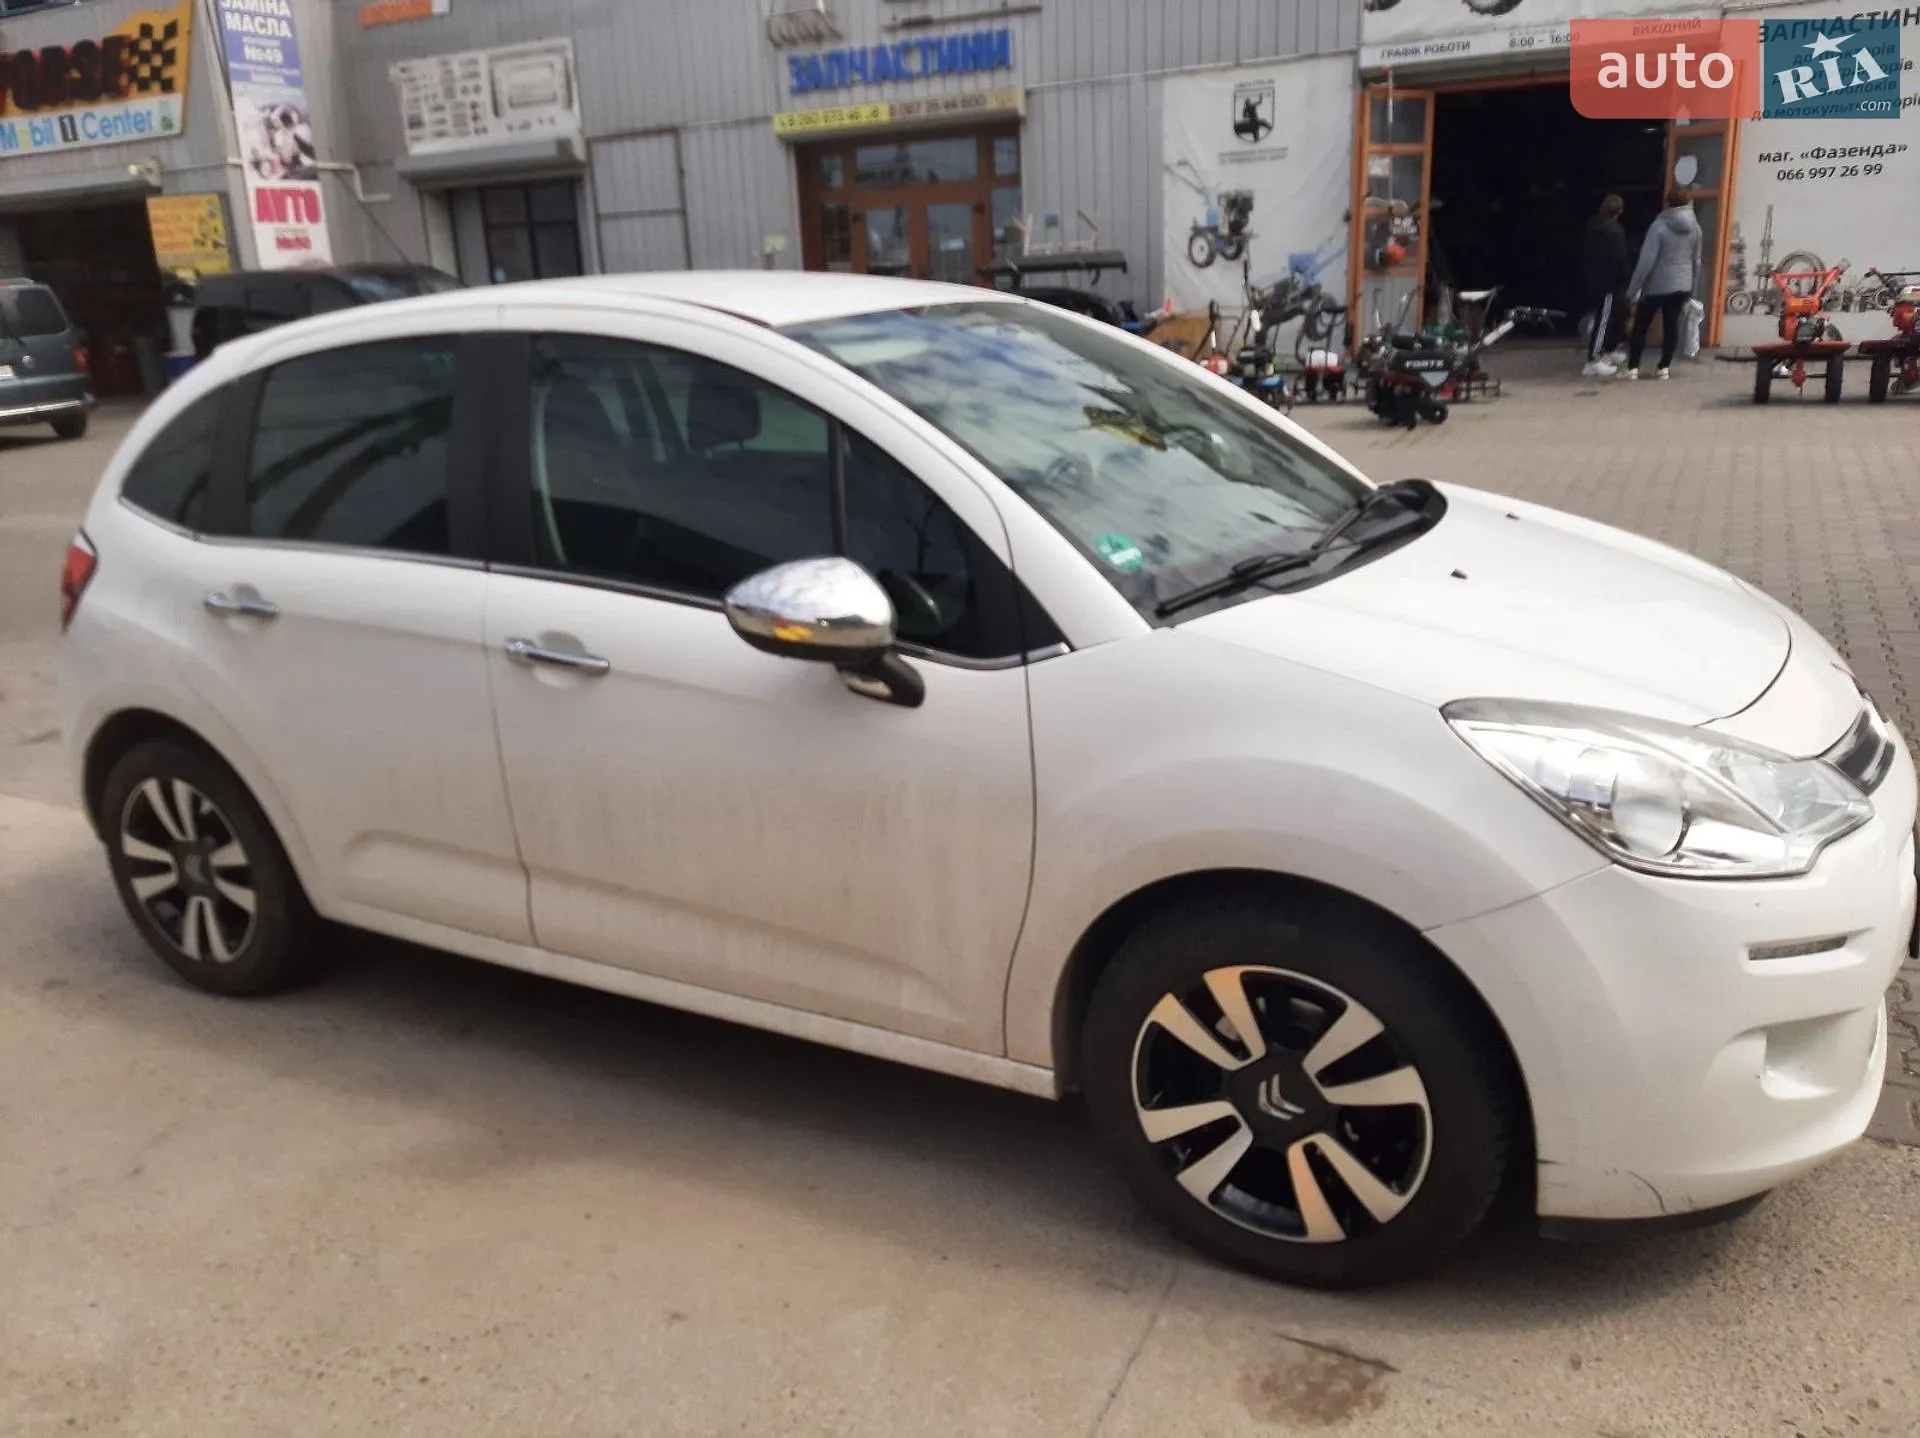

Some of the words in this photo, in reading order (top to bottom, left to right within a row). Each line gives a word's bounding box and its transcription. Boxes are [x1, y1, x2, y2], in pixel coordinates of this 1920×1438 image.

[225, 10, 293, 38] МАСЛА
[787, 26, 1013, 94] ЗАПЧАСТИНИ
[1379, 45, 1421, 59] ГРАФІК
[1423, 40, 1471, 55] РОБОТИ
[81, 109, 152, 140] Center
[1758, 151, 1794, 163] маг.
[1800, 143, 1908, 160] «Фазенда»
[1776, 169, 1805, 181] 066
[1808, 166, 1836, 179] 997
[1840, 164, 1860, 177] 26
[1863, 163, 1883, 175] 99
